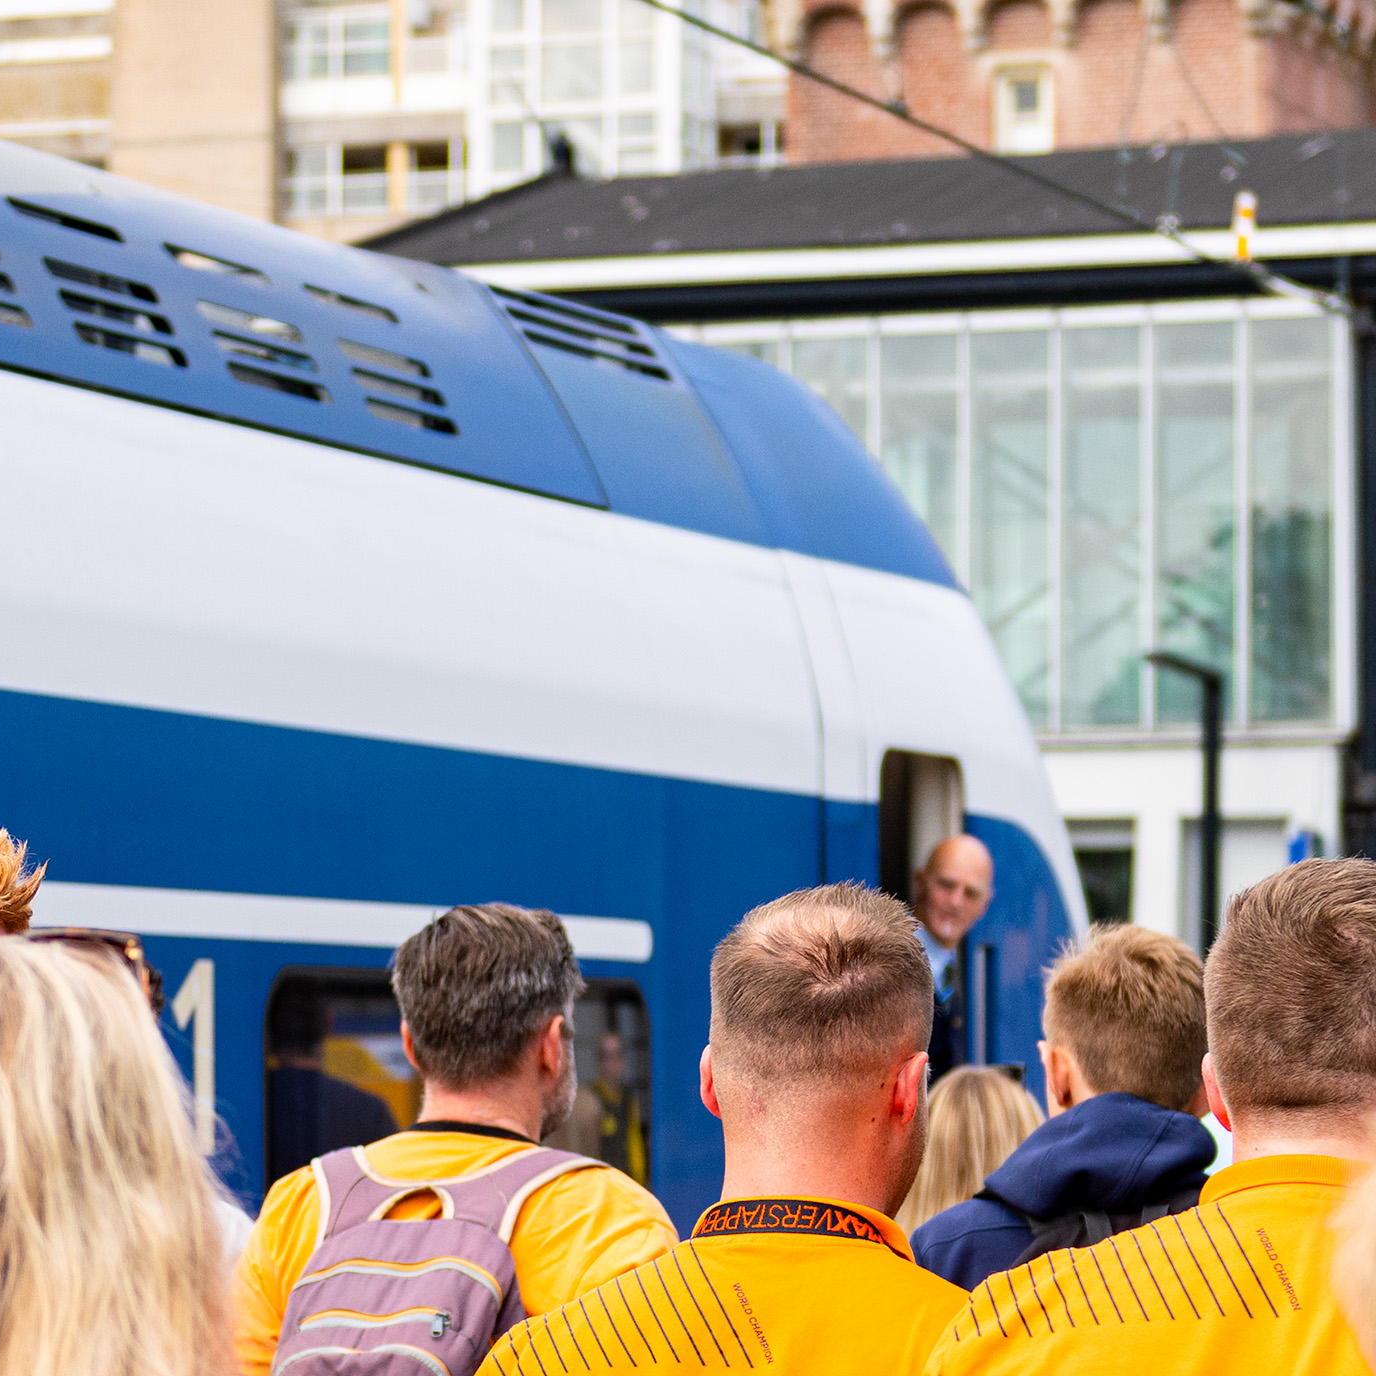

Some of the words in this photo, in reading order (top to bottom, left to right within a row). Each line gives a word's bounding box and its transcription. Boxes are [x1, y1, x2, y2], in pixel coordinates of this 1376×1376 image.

[171, 958, 215, 1156] 1
[1256, 1228, 1278, 1261] WORLD
[1274, 1263, 1301, 1310] CHAMPION
[732, 1282, 753, 1315] WORLD
[749, 1316, 774, 1364] CHAMPION
